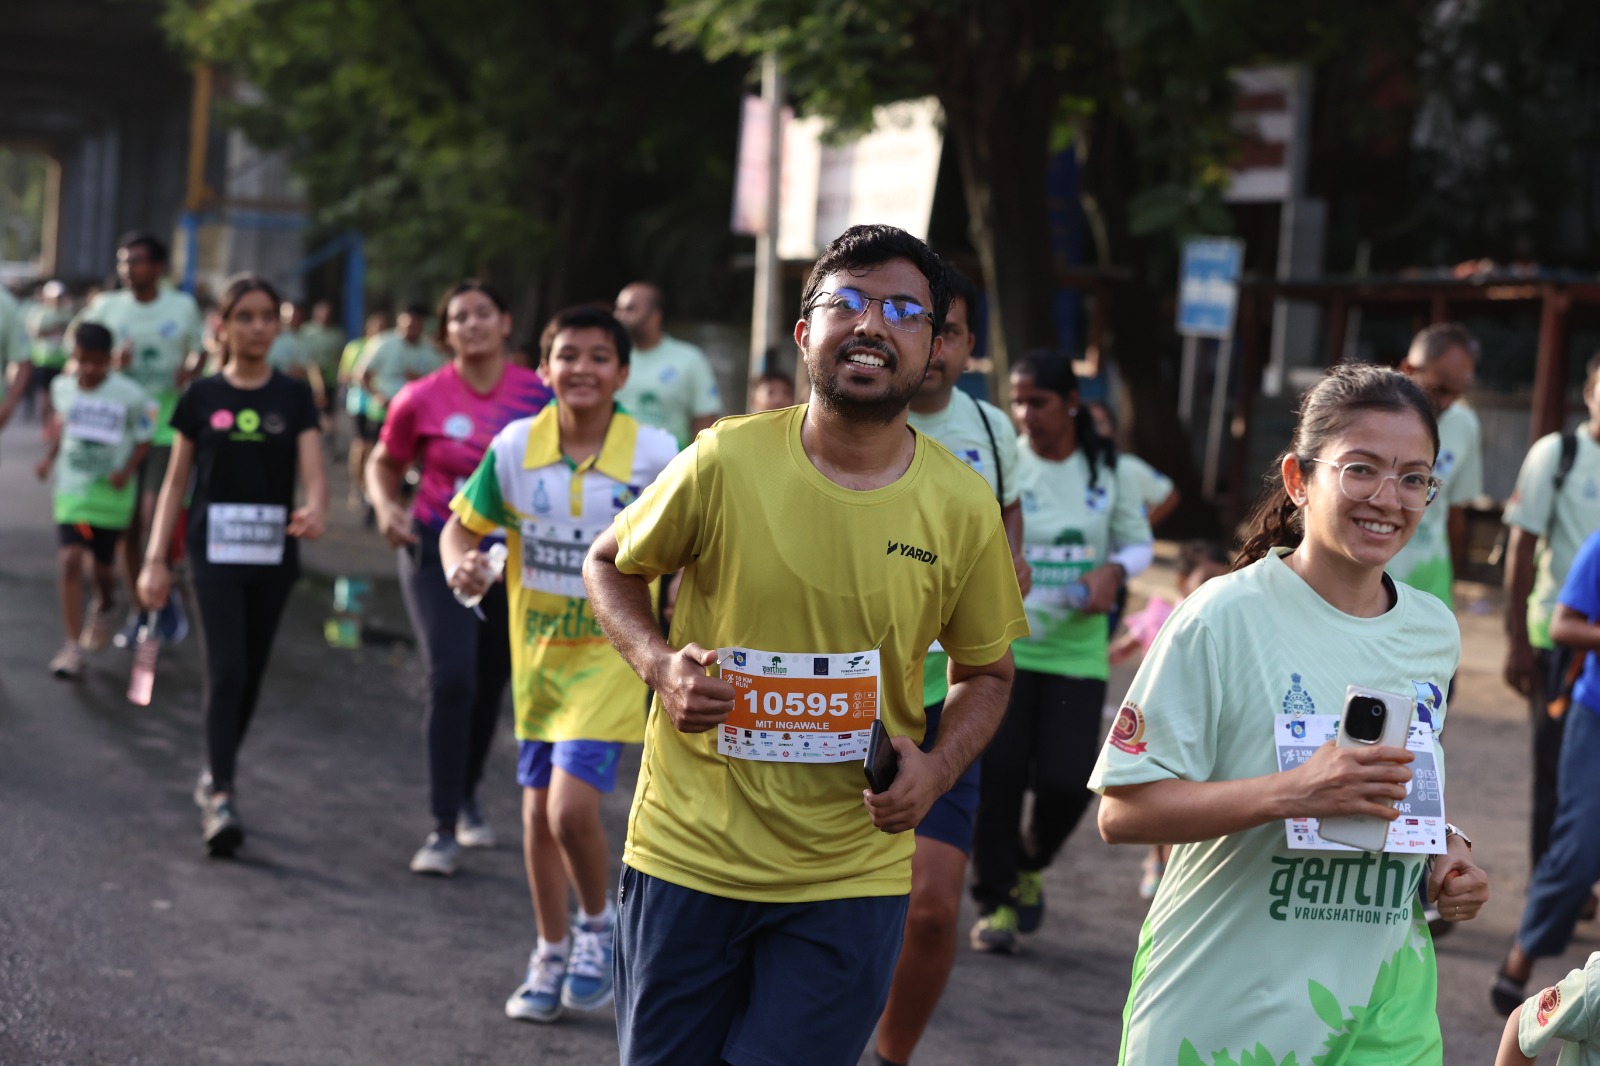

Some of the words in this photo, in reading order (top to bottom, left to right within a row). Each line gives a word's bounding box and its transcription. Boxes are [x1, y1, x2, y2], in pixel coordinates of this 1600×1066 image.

[900, 543, 938, 565] YARDI
[743, 690, 849, 716] 10595
[755, 720, 773, 728] MIT
[775, 721, 830, 730] INGAWALE
[1294, 906, 1381, 924] VRUKSHATHON
